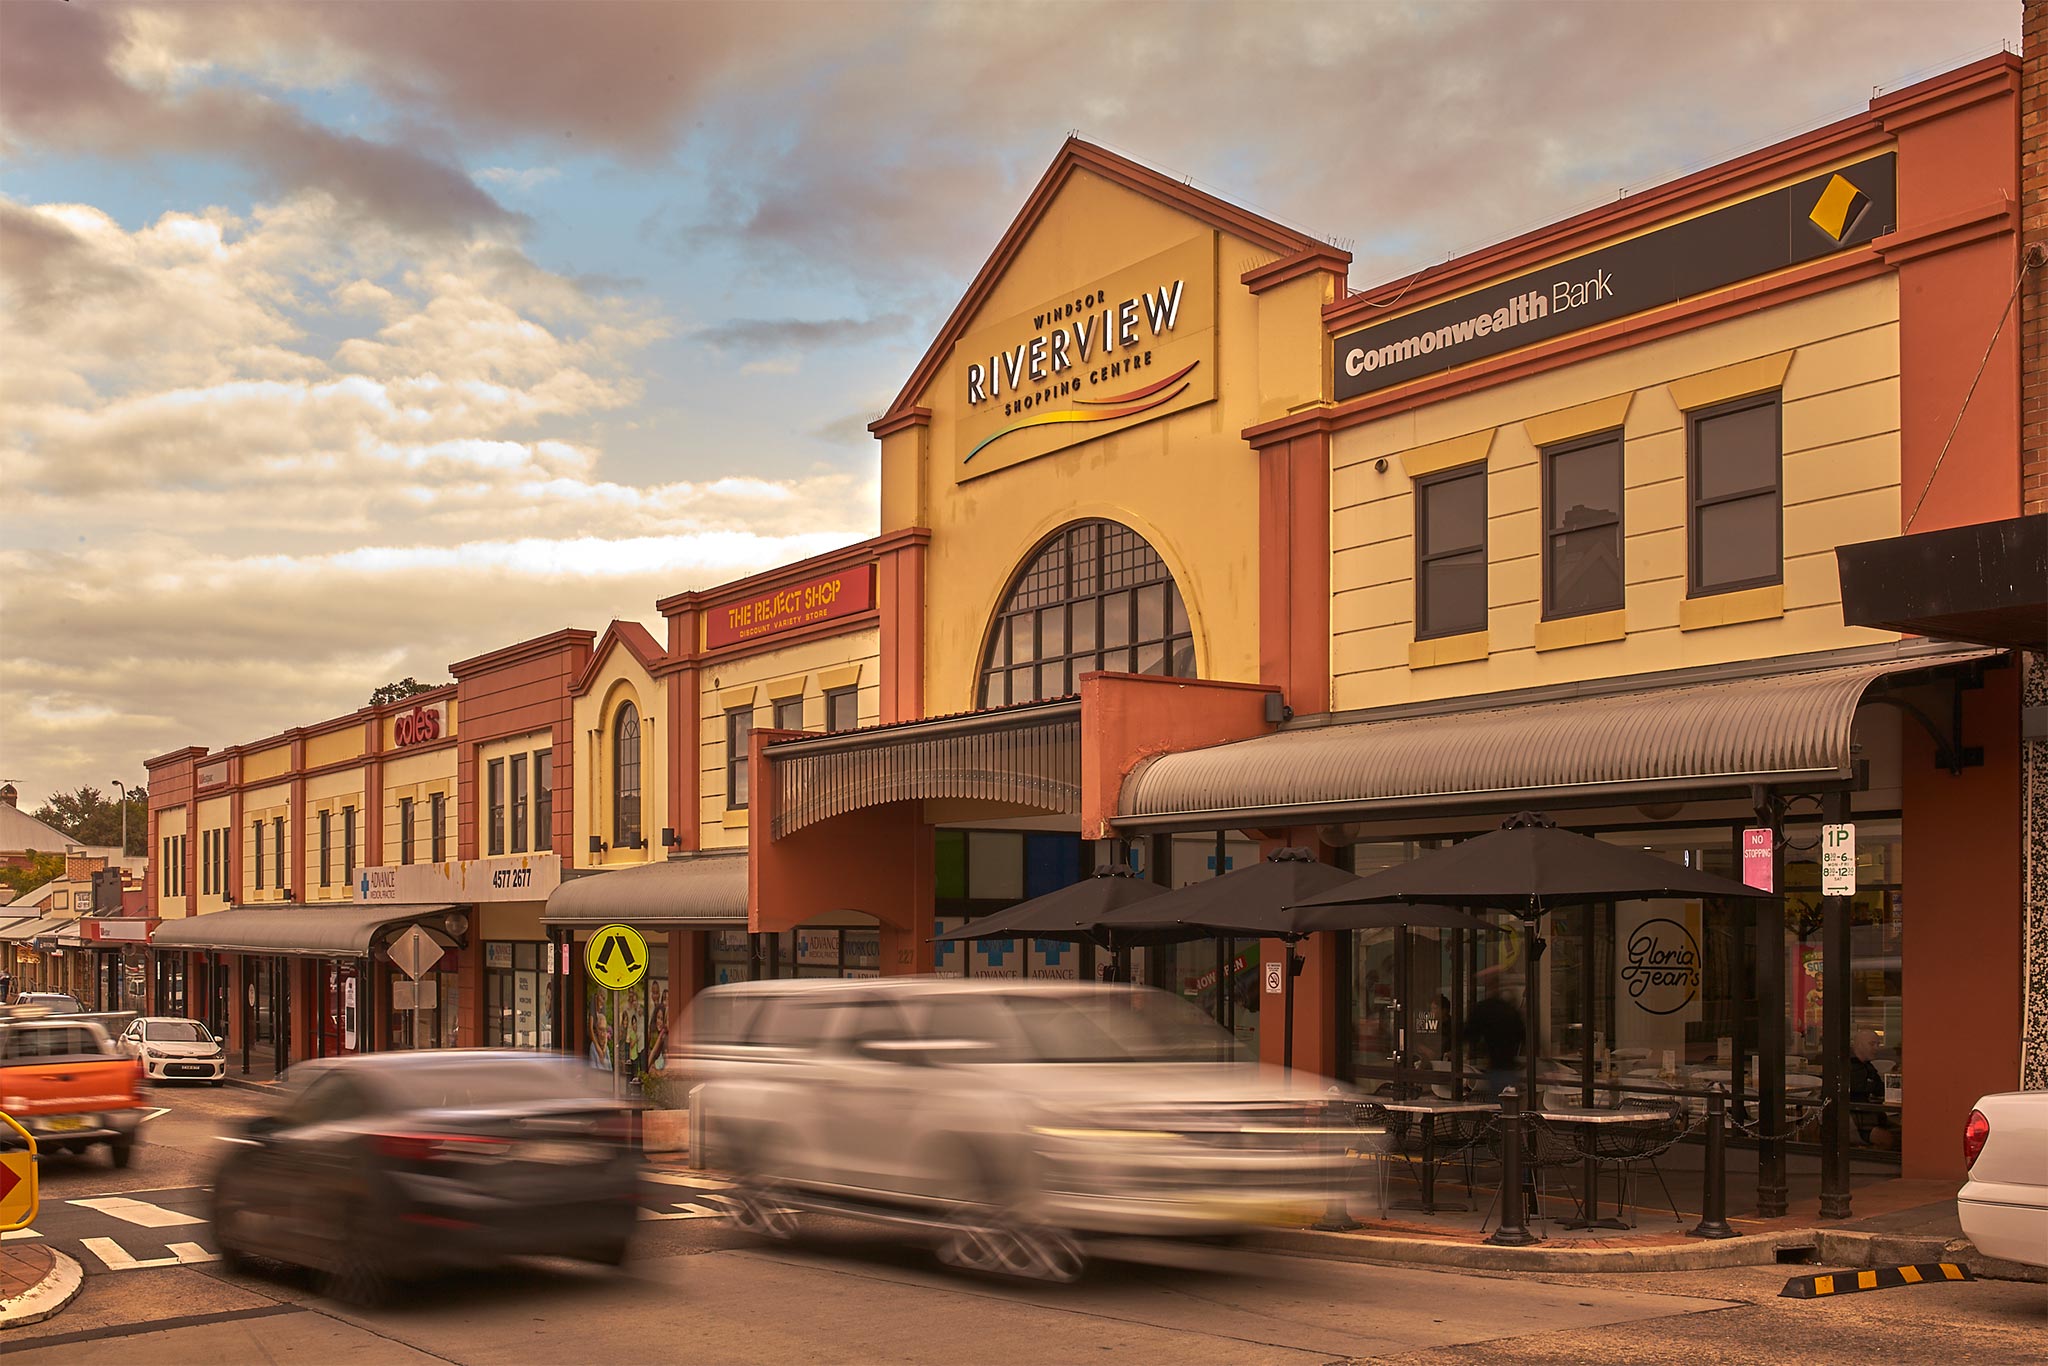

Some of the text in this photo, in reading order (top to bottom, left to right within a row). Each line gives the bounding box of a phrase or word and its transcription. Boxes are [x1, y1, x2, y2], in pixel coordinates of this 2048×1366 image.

[1034, 290, 1105, 330] WINDSOR
[1345, 268, 1614, 376] Commonwealth Bank
[967, 279, 1185, 405] RIVERVIEW
[1005, 351, 1152, 416] SHOPPING CENTRE
[728, 579, 841, 629] THE REJECT SHOP
[739, 608, 828, 638] DISCOUNT VARIETY STORE
[394, 706, 440, 747] coles
[1744, 848, 1771, 858] STOPPING
[1751, 834, 1764, 845] NO
[1828, 830, 1849, 847] 1P
[493, 868, 532, 888] 4577 2677
[809, 936, 839, 950] ADVANCE
[898, 949, 914, 964] 227
[1621, 936, 1695, 980] Gloria
[1032, 969, 1074, 980] ADVANCE
[1628, 967, 1700, 998] Jean's
